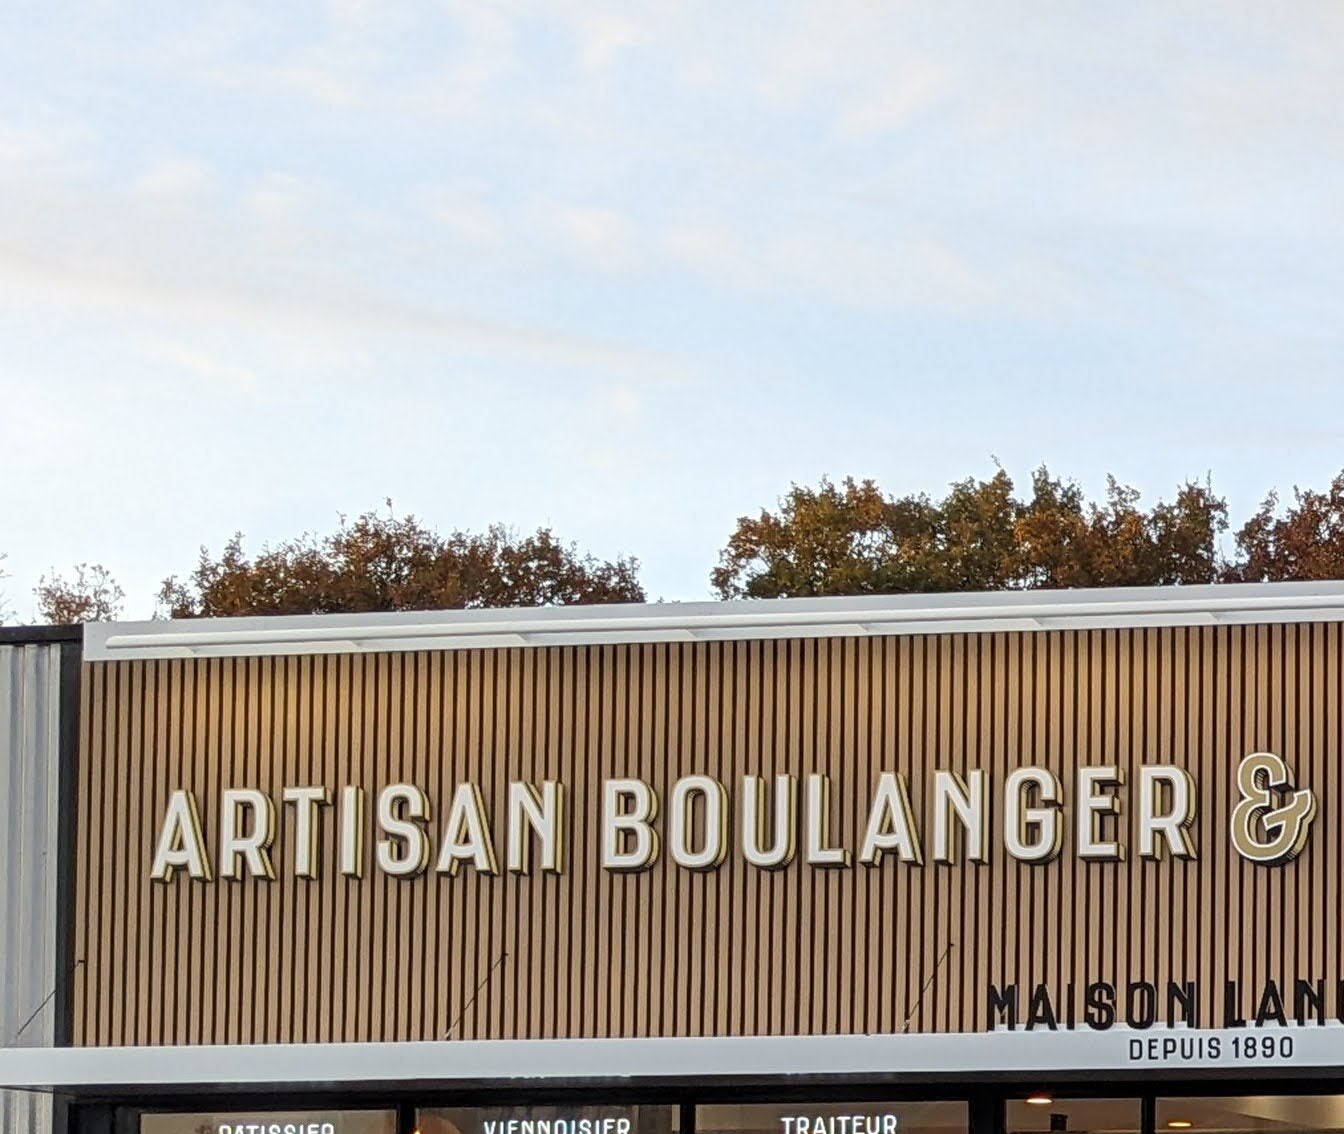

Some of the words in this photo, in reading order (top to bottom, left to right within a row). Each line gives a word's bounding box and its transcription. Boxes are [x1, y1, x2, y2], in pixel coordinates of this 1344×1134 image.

[150, 780, 566, 882] ARTISAN
[602, 763, 1198, 874] BOULANGER
[1231, 751, 1317, 866] &
[986, 981, 1196, 1032] MAISON
[1128, 1036, 1222, 1061] DEPUIS
[1231, 1035, 1294, 1060] 1890
